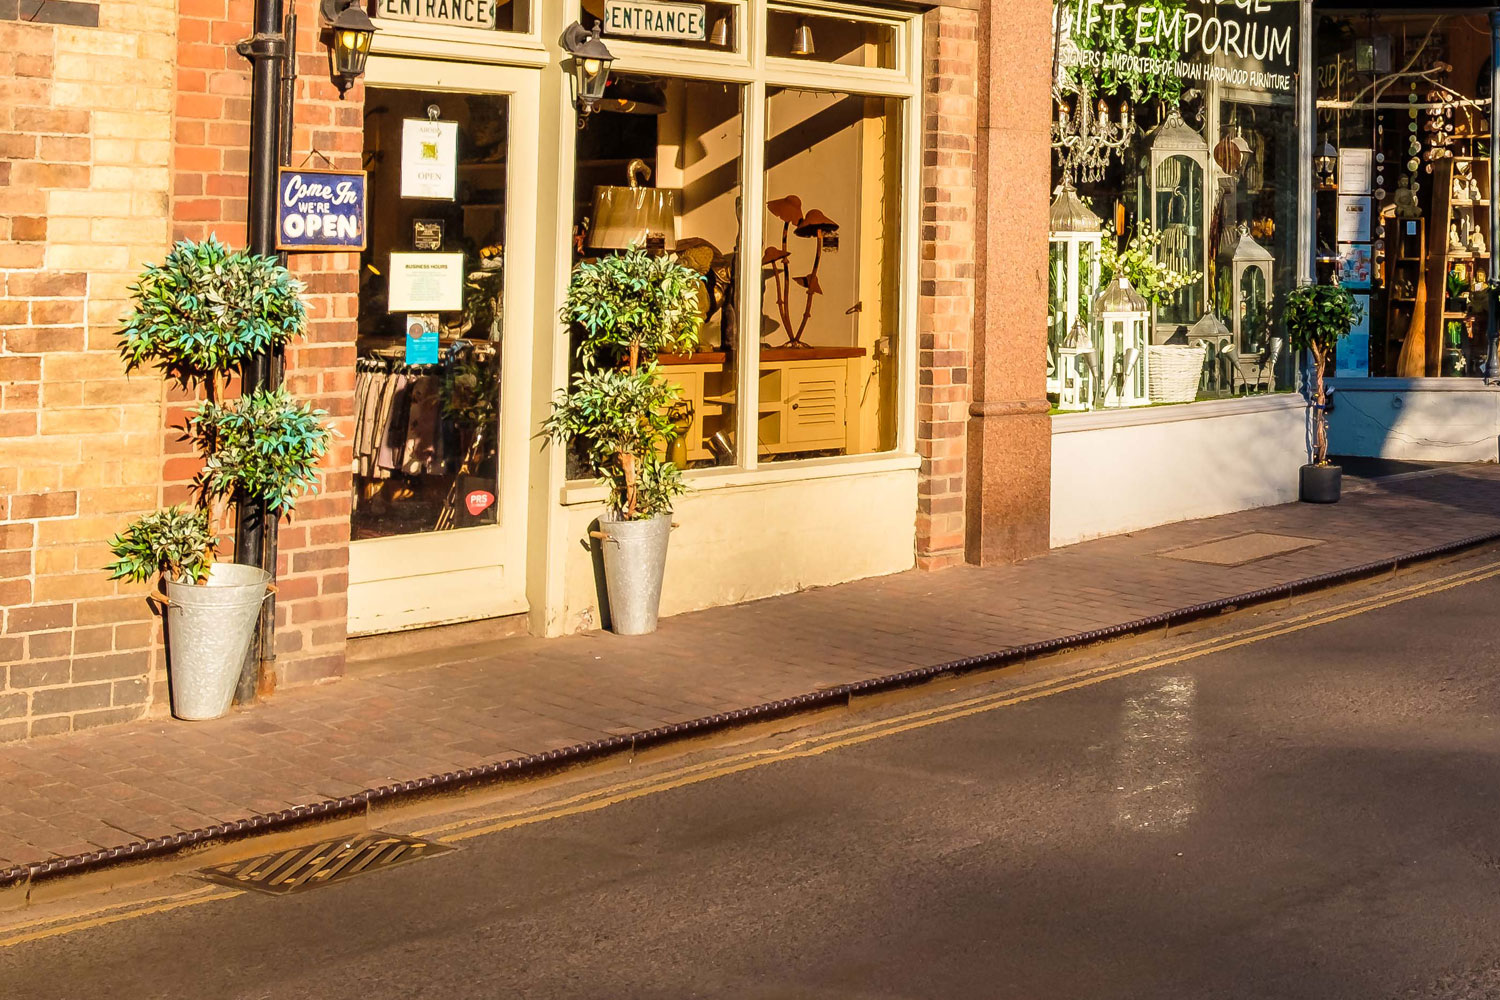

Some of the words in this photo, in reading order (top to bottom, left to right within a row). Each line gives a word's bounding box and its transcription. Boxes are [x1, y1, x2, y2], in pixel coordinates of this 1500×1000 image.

[611, 6, 698, 34] ENTRANCE
[1135, 6, 1292, 66] EMPORIUM
[1052, 49, 1101, 69] ESIGNERS
[1102, 51, 1109, 69] &
[1111, 52, 1161, 75] IMPORTERS
[1161, 60, 1174, 76] OF
[1174, 60, 1202, 78] INDIAN
[1203, 64, 1249, 85] HARDWOOD
[1249, 71, 1291, 90] FURNITURE
[418, 172, 441, 181] OPEN
[284, 175, 333, 207] Come
[331, 181, 358, 205] In
[298, 202, 330, 214] WE'RE
[283, 213, 357, 239] OPEN
[470, 494, 488, 504] PRS
